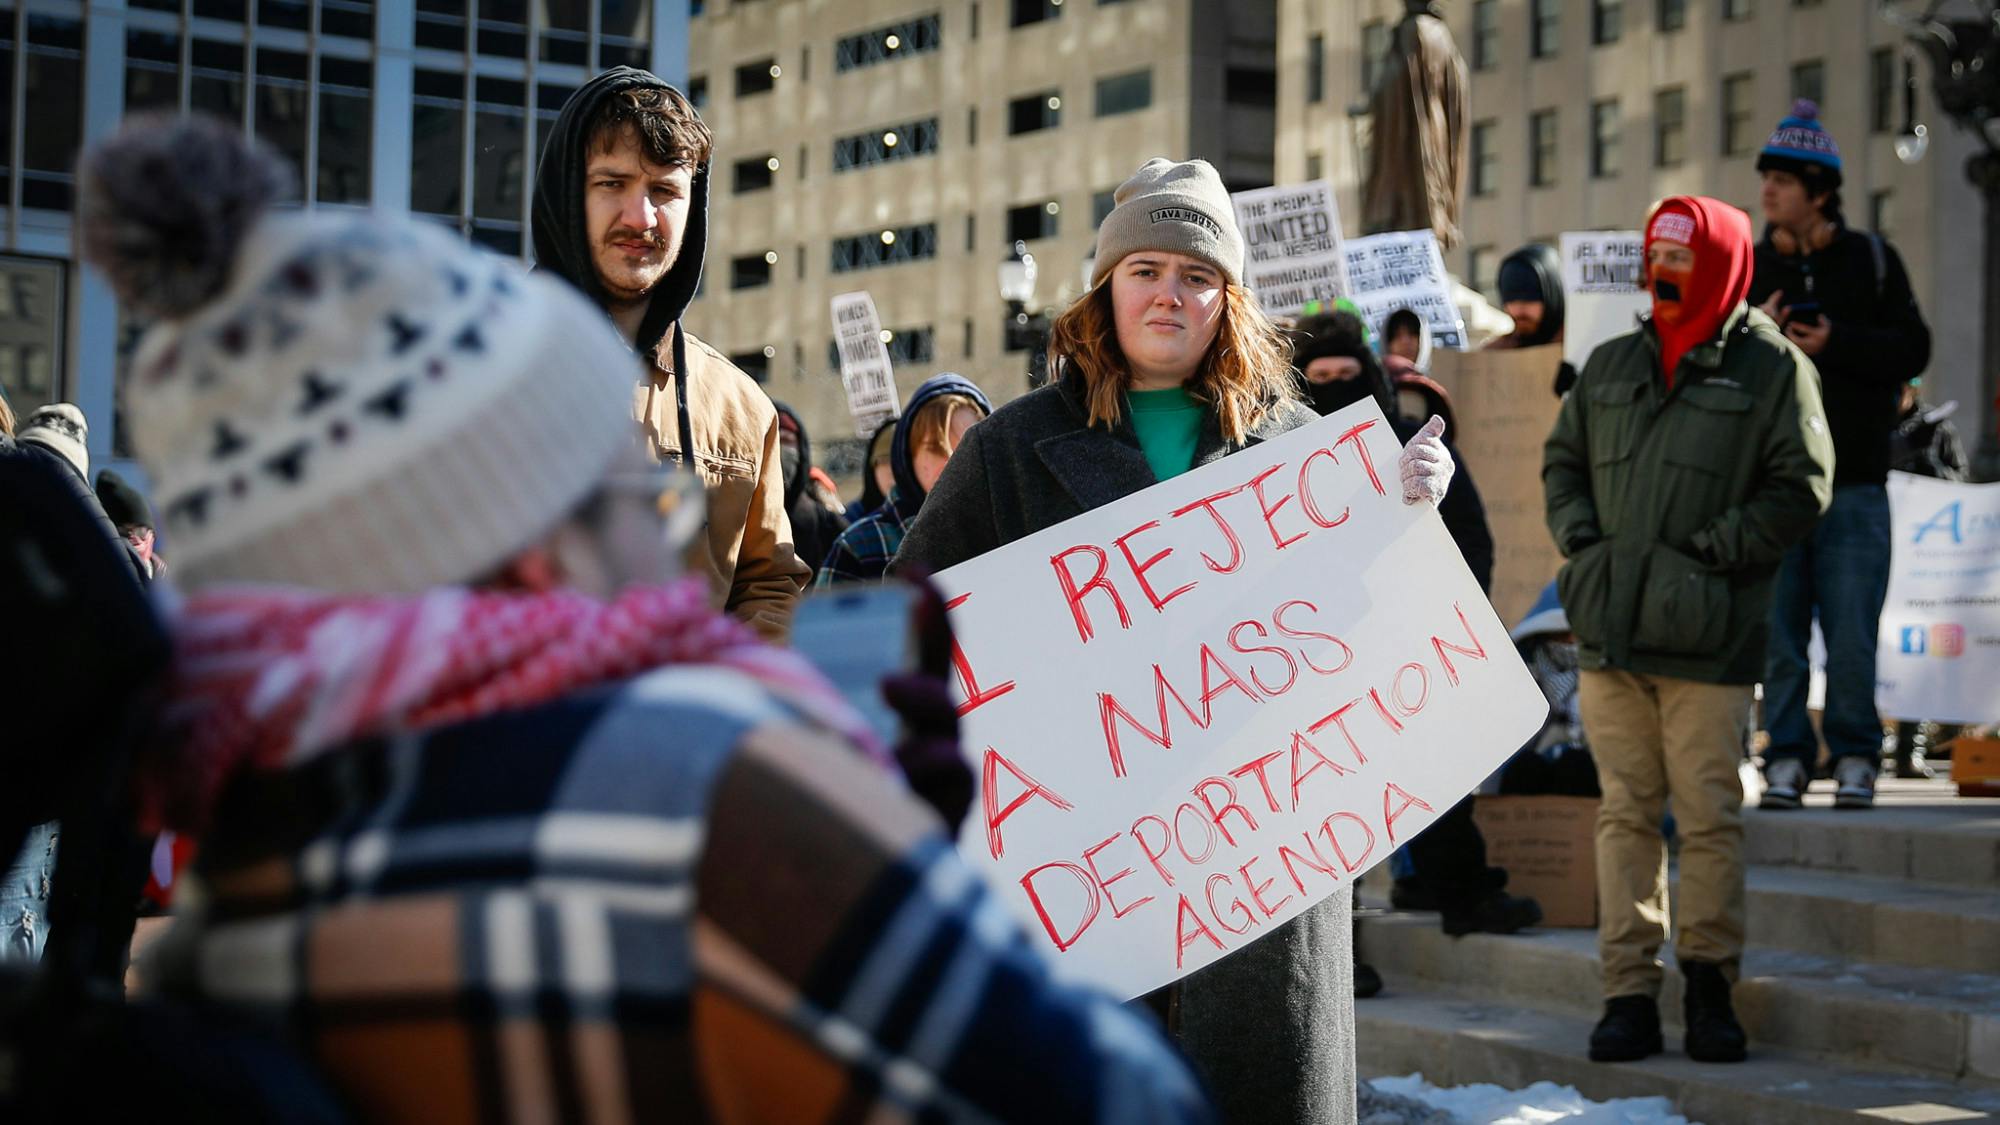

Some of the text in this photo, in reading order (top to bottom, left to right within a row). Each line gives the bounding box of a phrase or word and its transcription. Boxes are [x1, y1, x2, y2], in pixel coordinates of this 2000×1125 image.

[1154, 209, 1219, 237] JAVA HOUSE
[1246, 209, 1329, 247] UNITED
[1049, 418, 1387, 645] REJECT
[981, 599, 1354, 862] A MASS
[1019, 599, 1489, 953] DEPORTATION
[1173, 781, 1437, 970] AGENDA
